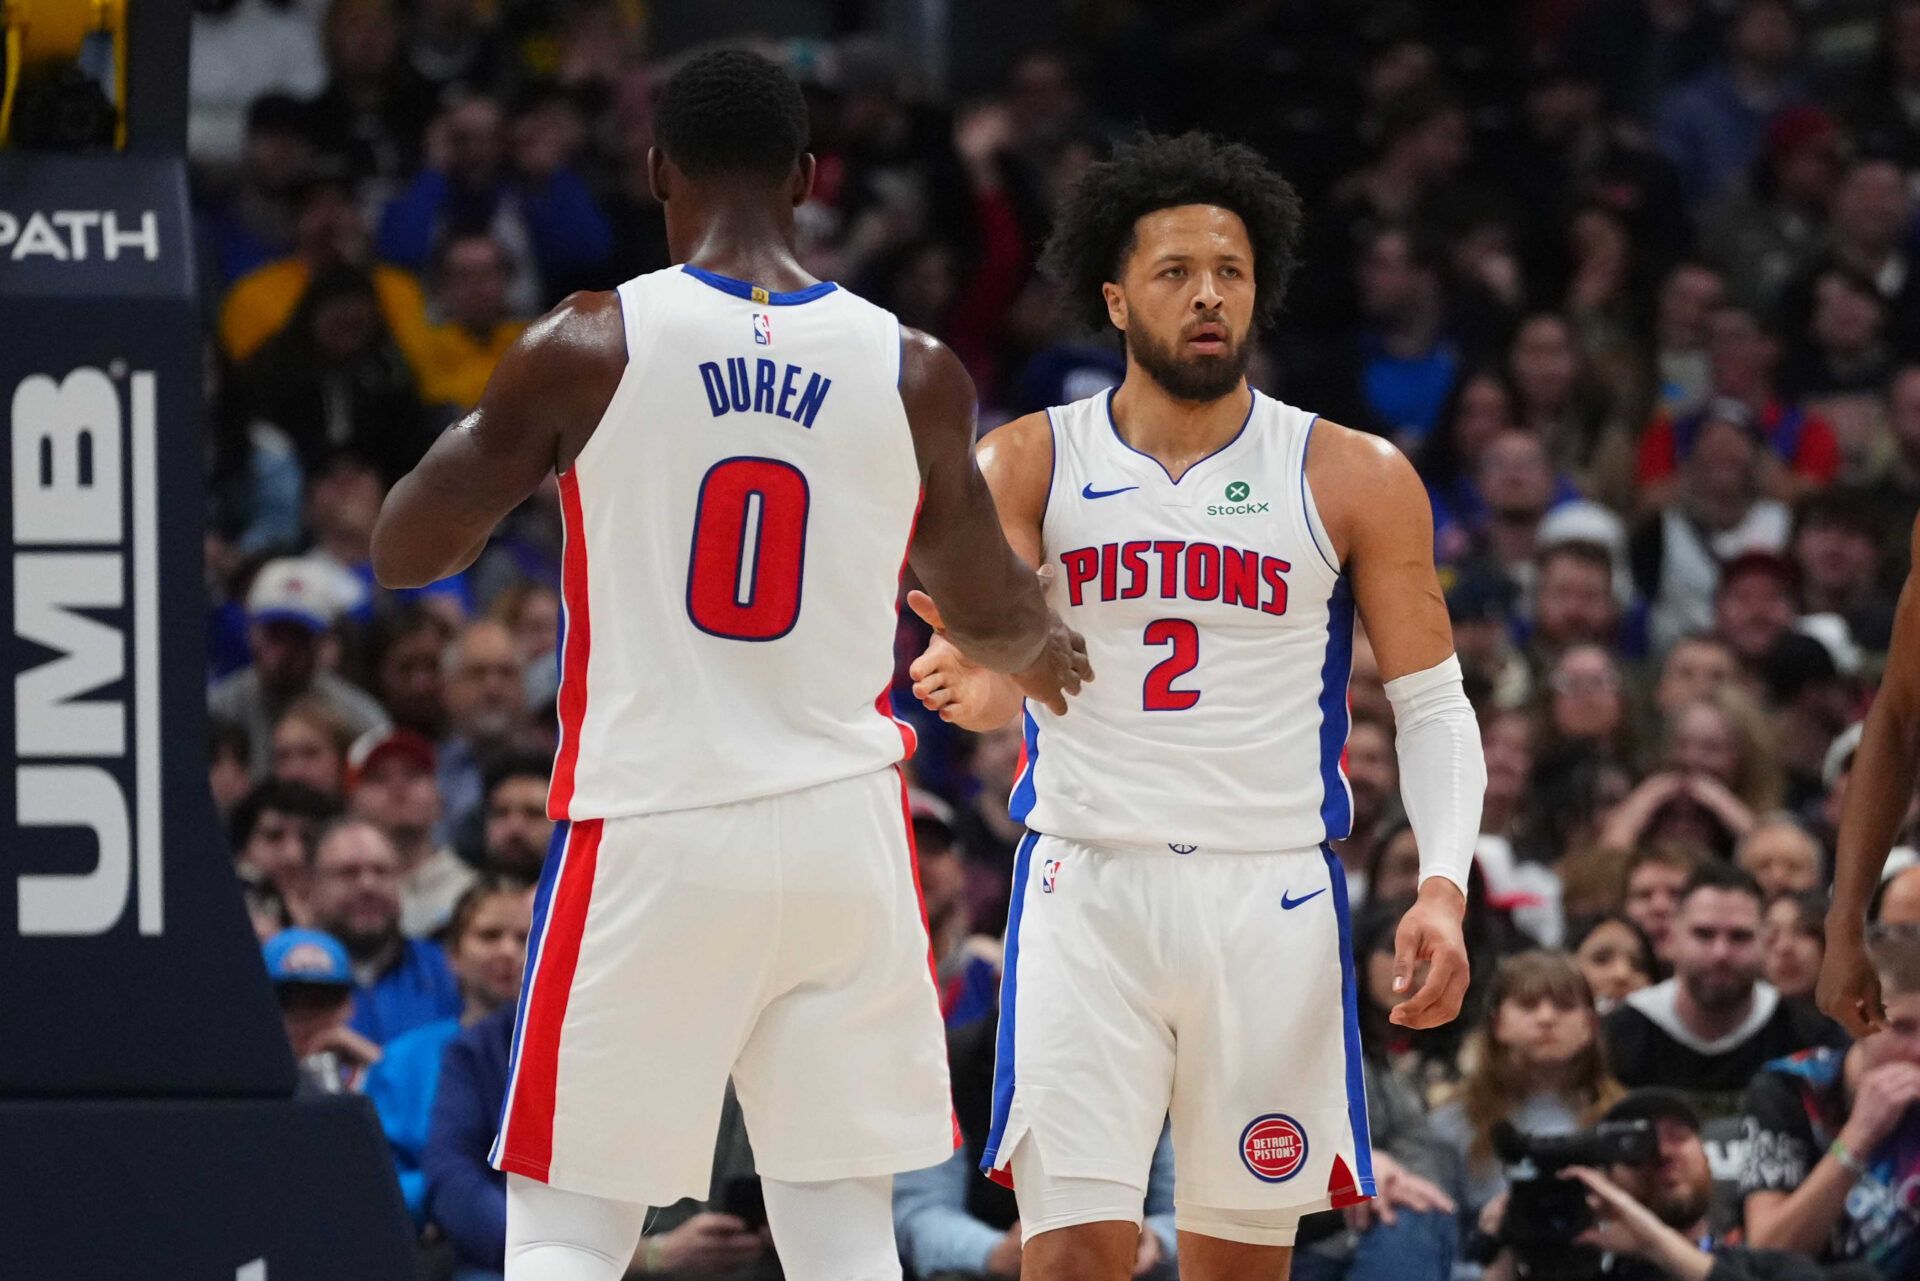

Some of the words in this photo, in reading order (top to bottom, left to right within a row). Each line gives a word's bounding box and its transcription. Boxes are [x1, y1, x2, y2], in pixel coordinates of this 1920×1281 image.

[698, 357, 832, 429] DUREN
[1206, 501, 1269, 516] StockX
[686, 456, 810, 642] 0
[1060, 540, 1291, 616] PISTONS
[11, 366, 132, 937] UMB
[1142, 617, 1201, 712] 2
[1252, 1135, 1294, 1150] DETROIT
[1253, 1146, 1296, 1161] PISTONS
